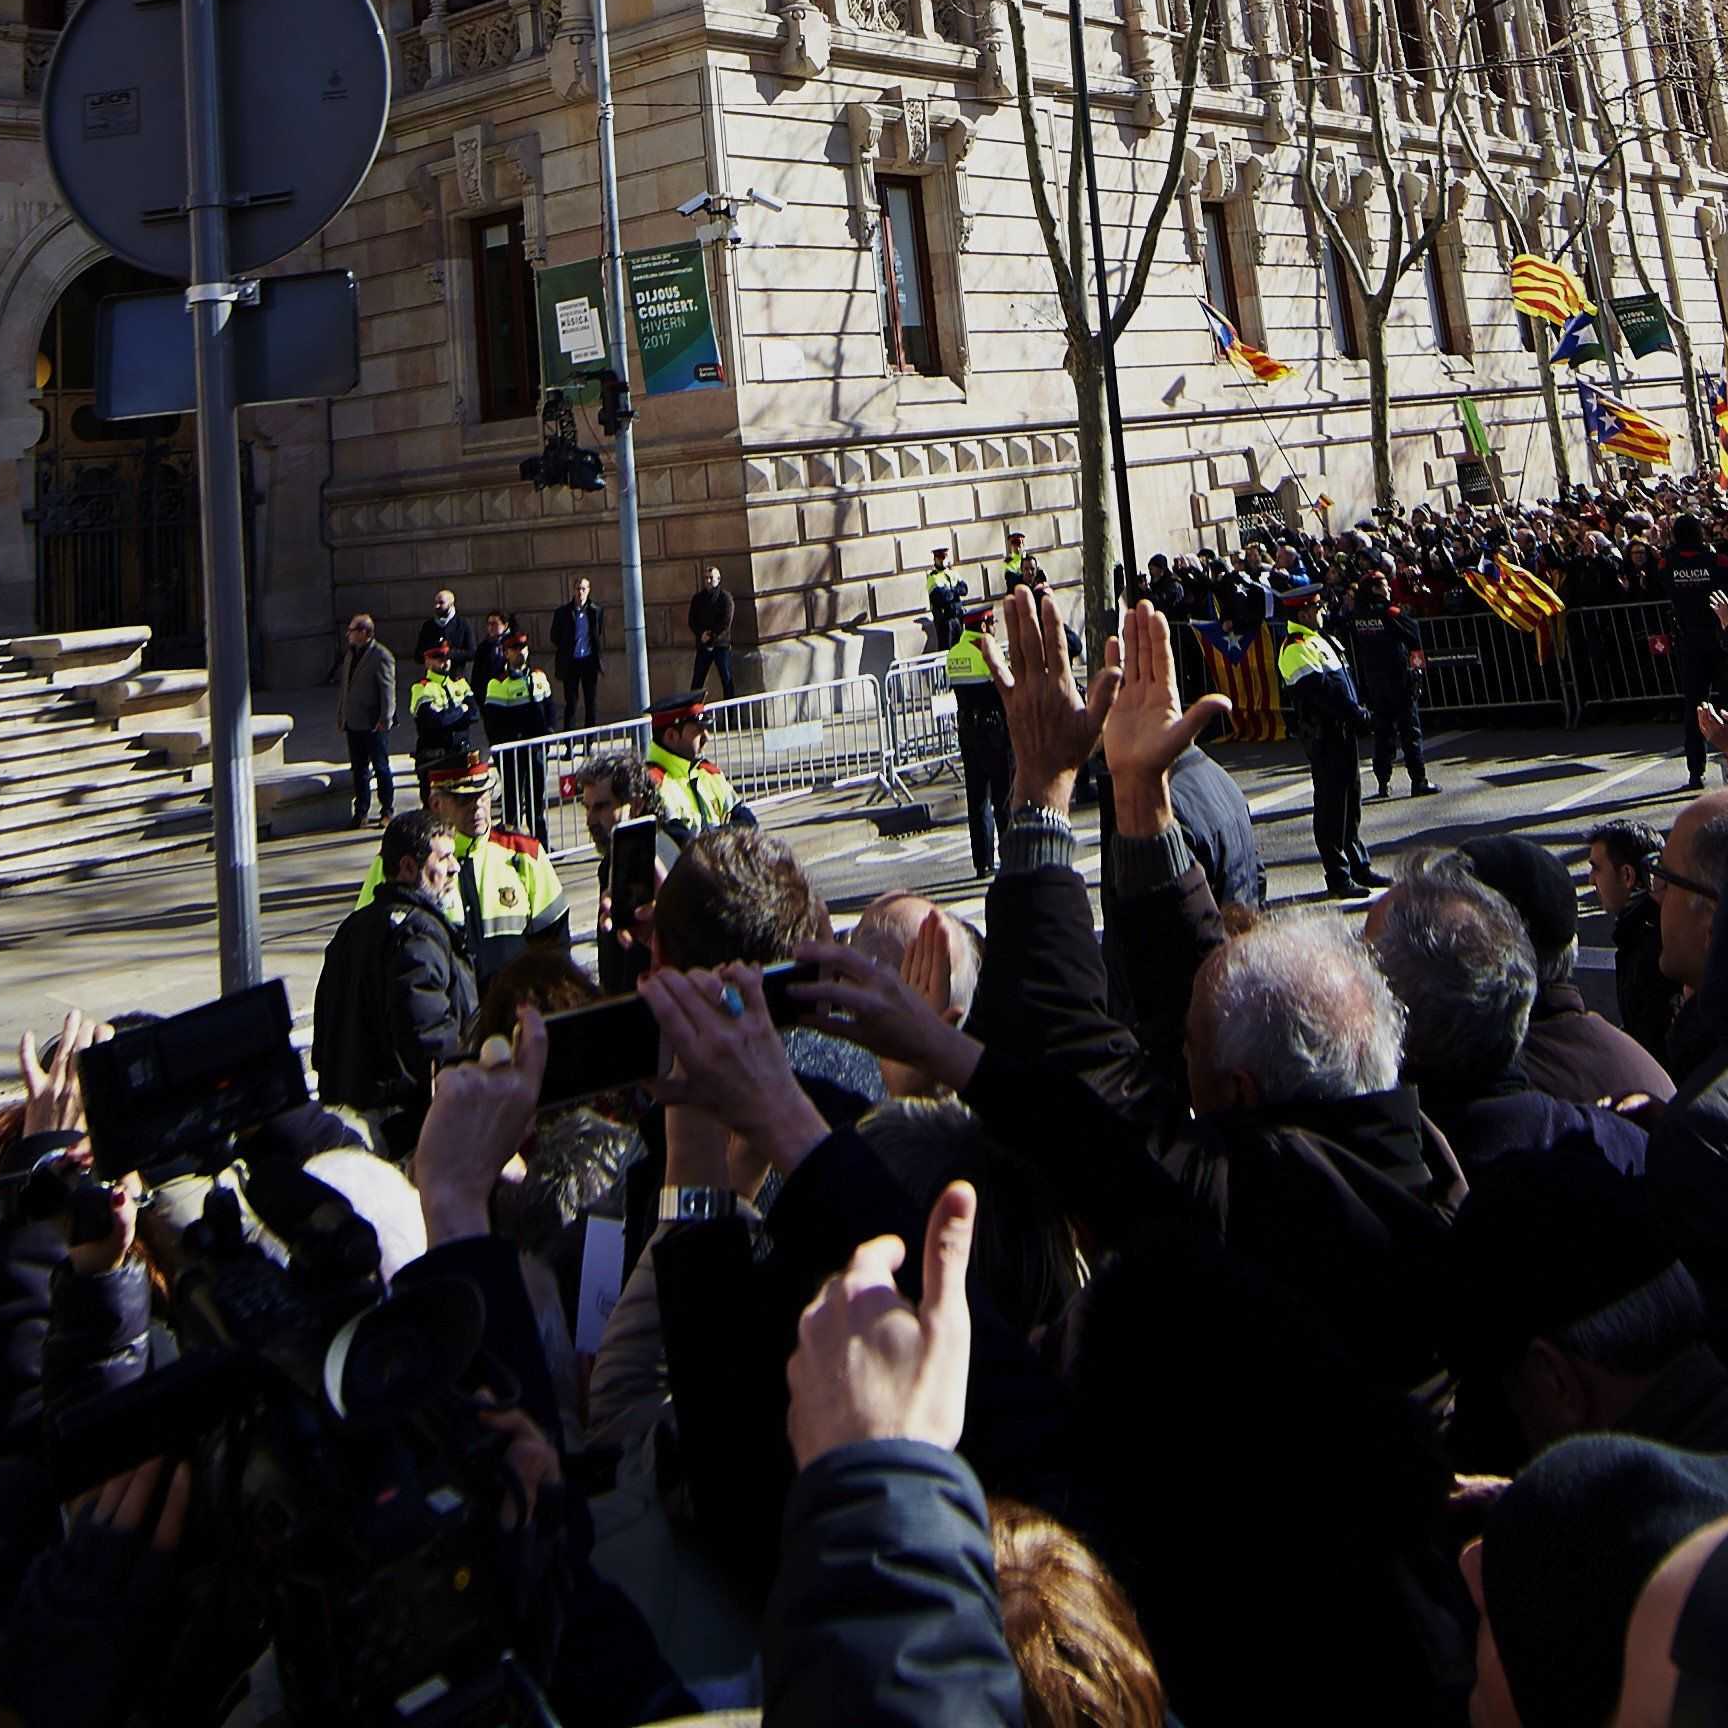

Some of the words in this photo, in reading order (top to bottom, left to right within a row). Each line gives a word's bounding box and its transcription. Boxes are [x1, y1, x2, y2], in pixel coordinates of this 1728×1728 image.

[636, 285, 681, 305] DIJOUS
[638, 299, 699, 319] CONCERT.
[640, 316, 686, 334] HIVERN
[643, 333, 671, 350] 2017
